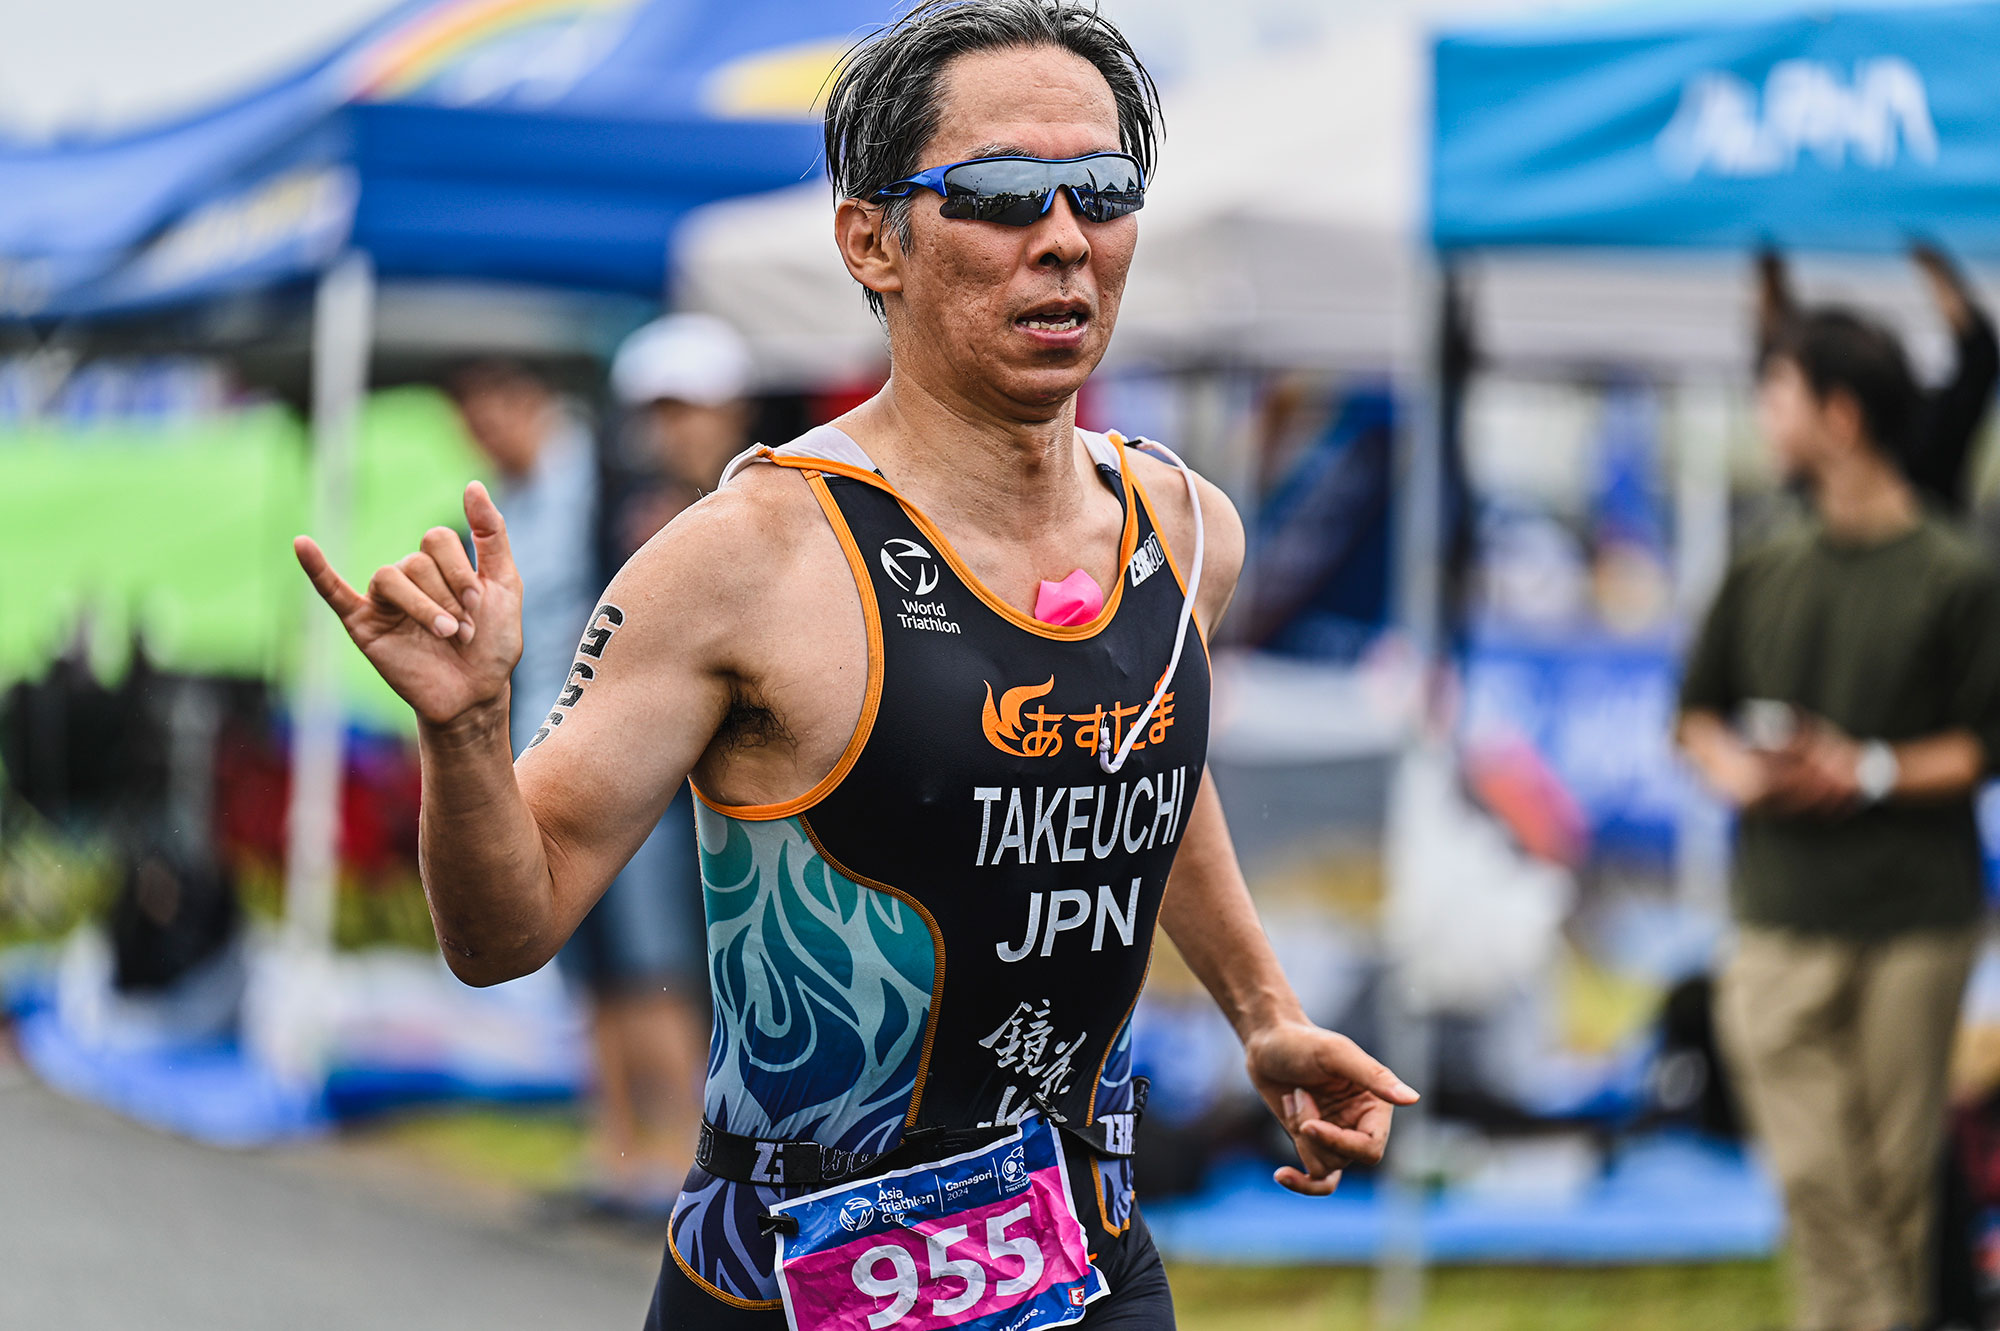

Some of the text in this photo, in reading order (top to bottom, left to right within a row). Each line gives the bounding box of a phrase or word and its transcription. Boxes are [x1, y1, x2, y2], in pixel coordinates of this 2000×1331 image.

[902, 599, 946, 617] World
[897, 613, 961, 635] Triathlon
[1022, 672, 1176, 758] あすたま
[973, 765, 1186, 866] TAKEUCHI
[995, 877, 1142, 963] JPN
[945, 1169, 993, 1192] Gamagori
[878, 1187, 904, 1202] Asia
[879, 1194, 935, 1213] Triathlon
[947, 1187, 969, 1202] 2024
[882, 1212, 905, 1224] Cup
[851, 1202, 1045, 1331] 955
